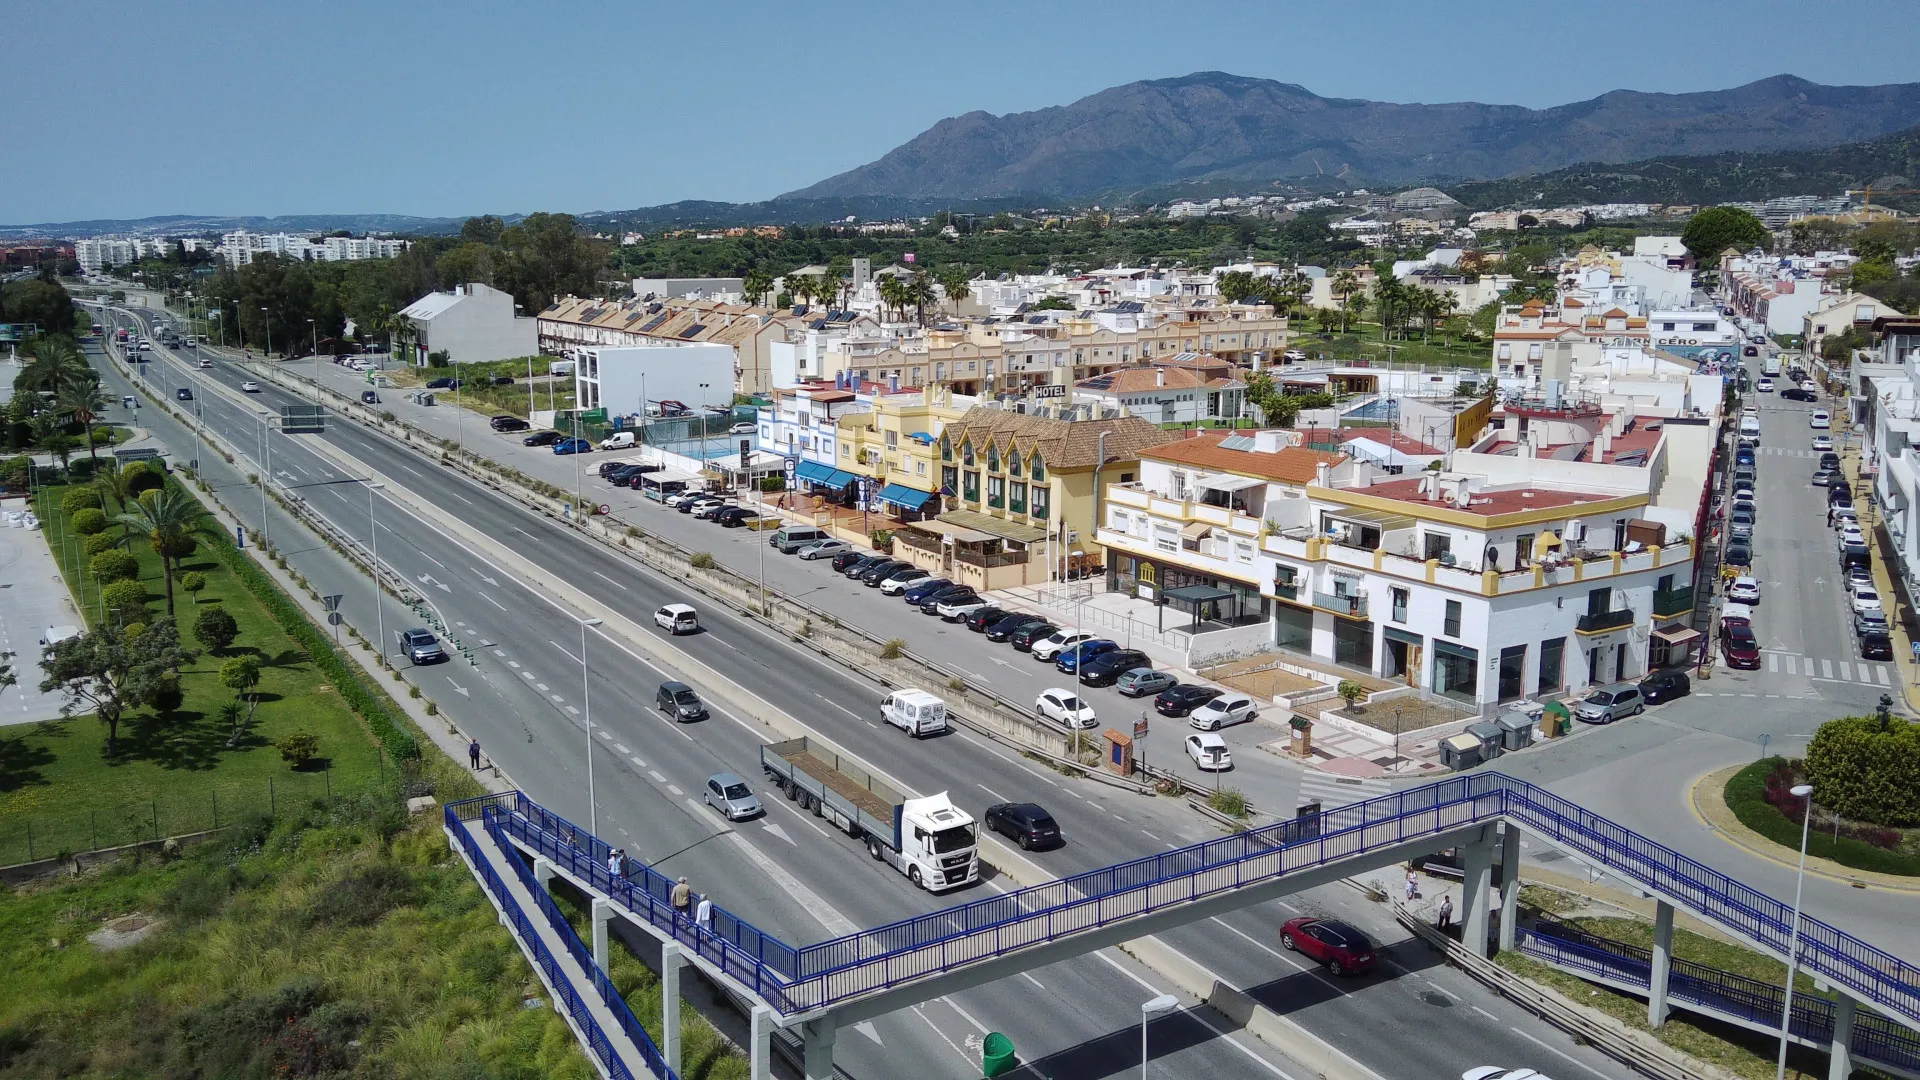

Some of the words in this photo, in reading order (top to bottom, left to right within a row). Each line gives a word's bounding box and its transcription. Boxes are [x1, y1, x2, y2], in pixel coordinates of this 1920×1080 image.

[1613, 337, 1698, 345] CRNCERO
[1036, 386, 1065, 397] HOTEL
[785, 460, 796, 489] GYM
[858, 480, 866, 511] GYM
